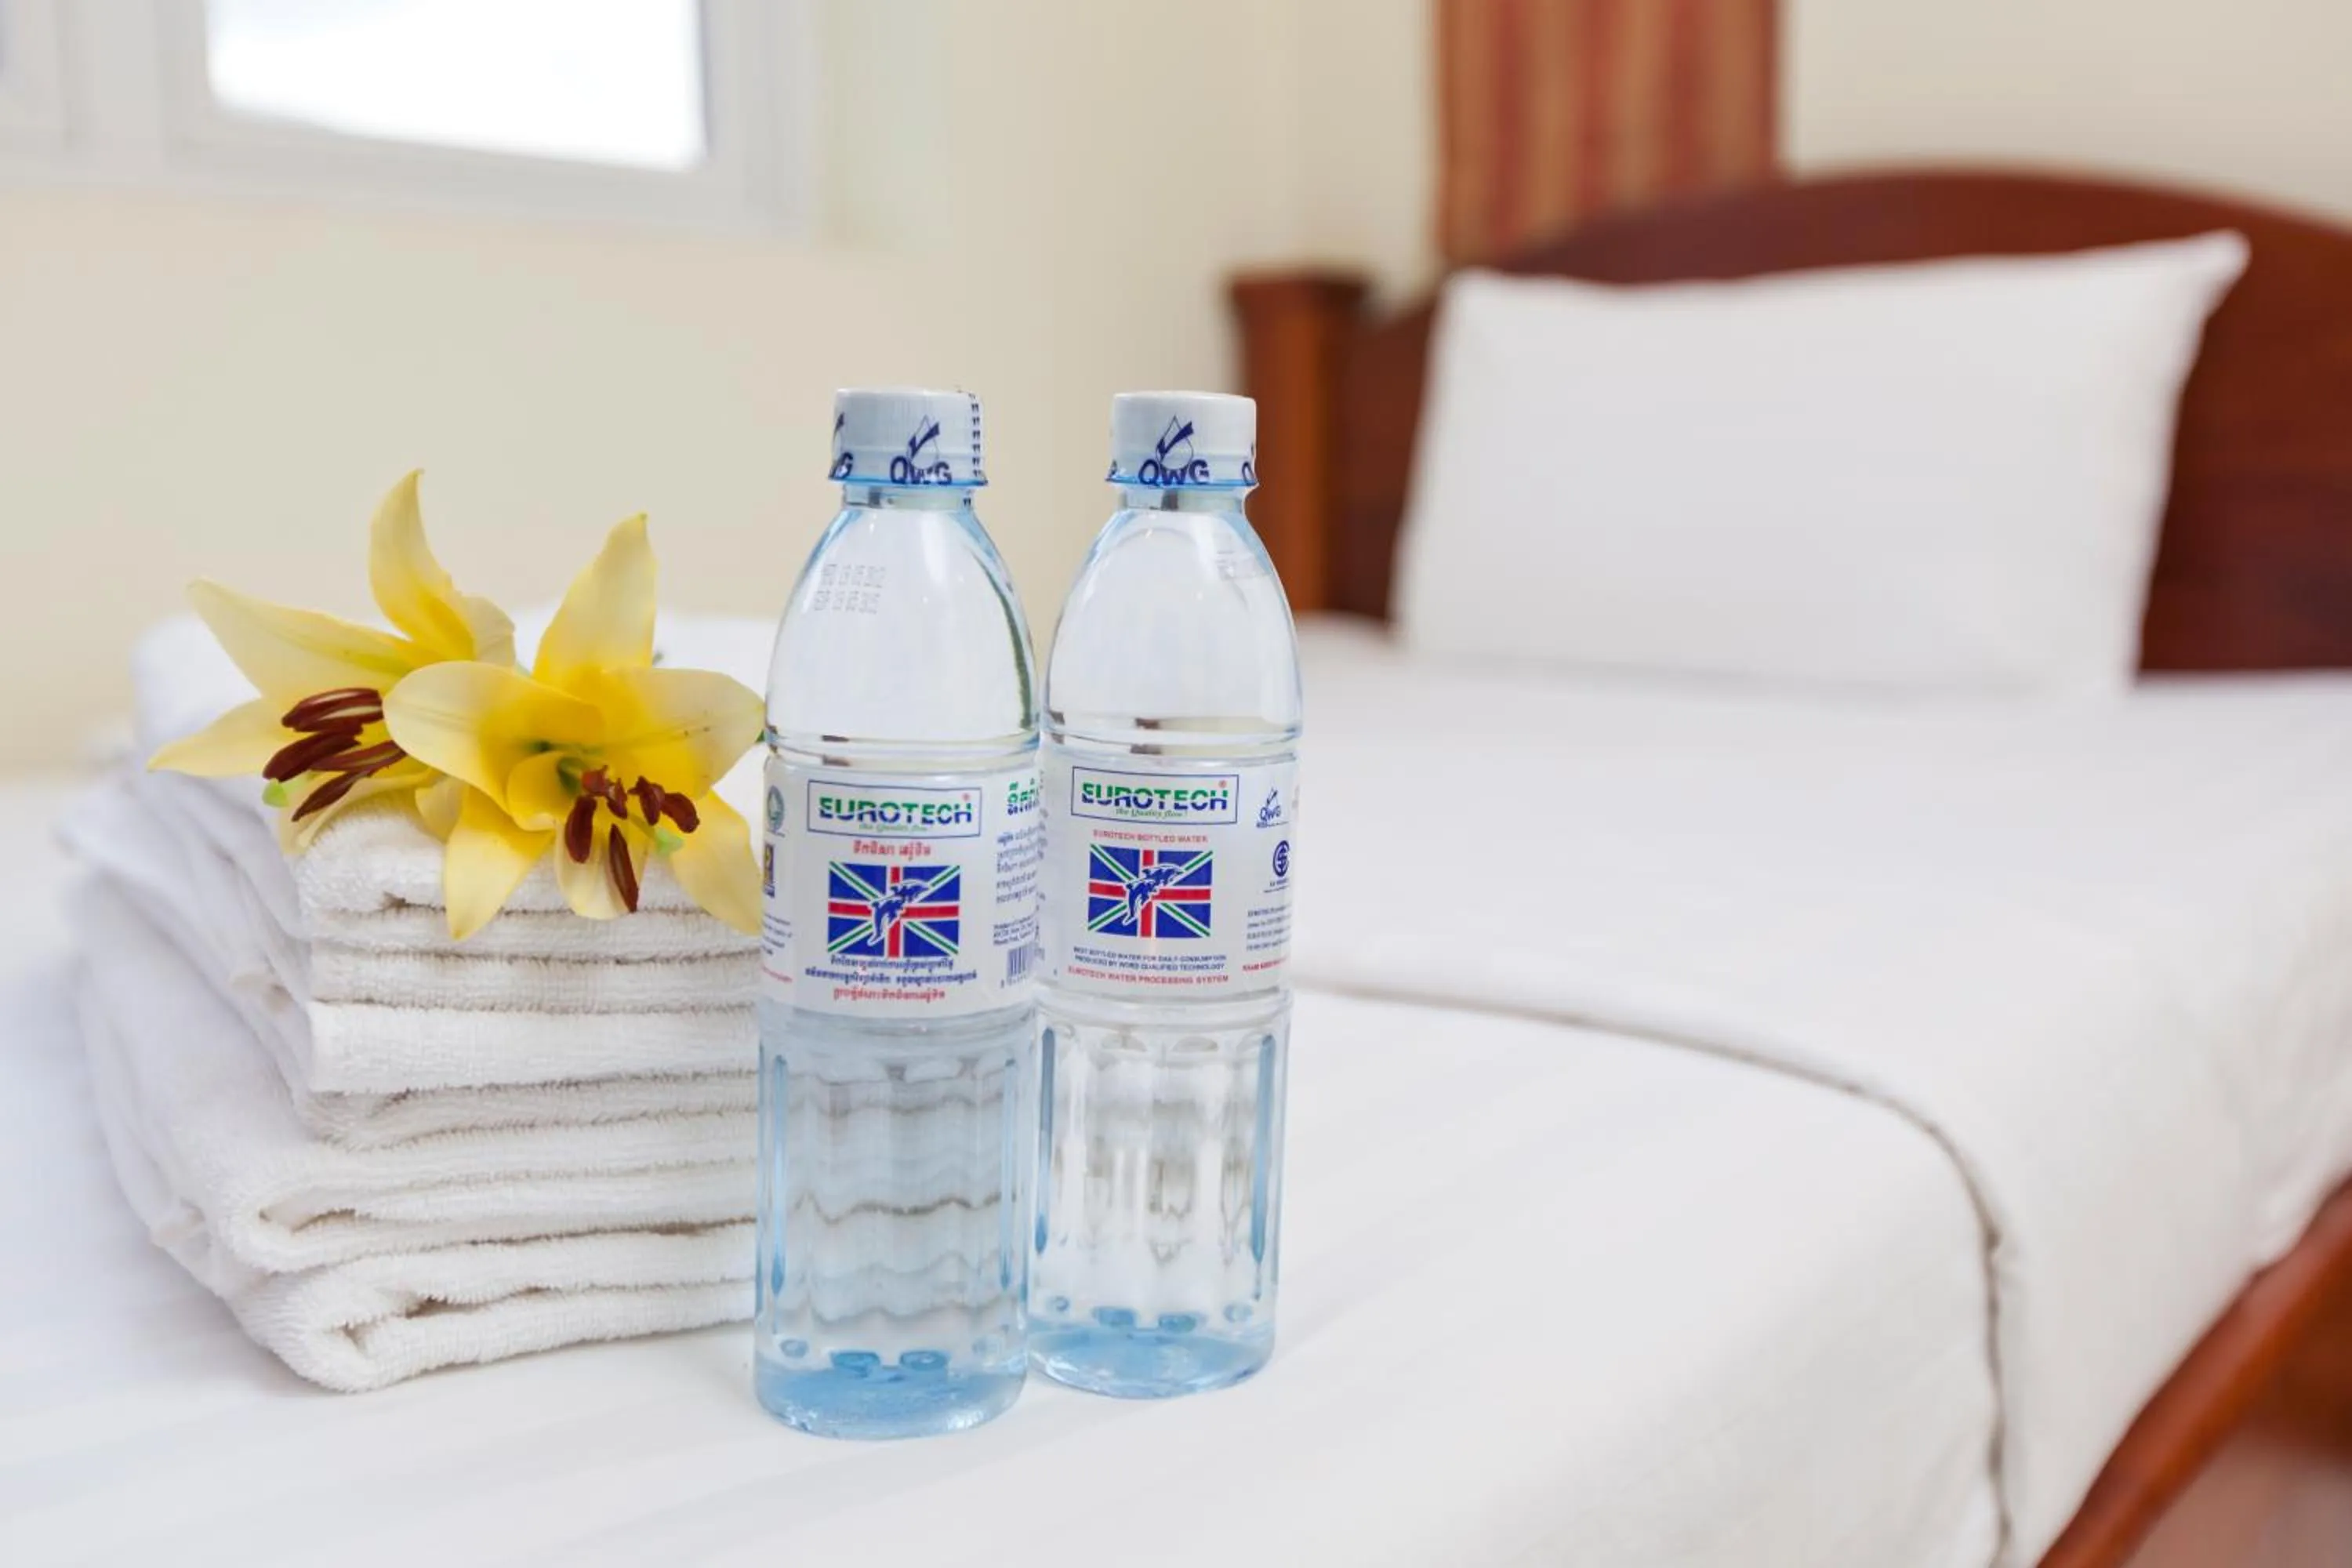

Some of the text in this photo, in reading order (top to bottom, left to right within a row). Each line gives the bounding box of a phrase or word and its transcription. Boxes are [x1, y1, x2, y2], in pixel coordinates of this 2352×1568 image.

[890, 456, 953, 485] QWG
[1138, 459, 1210, 487] QWG
[1080, 782, 1229, 811] EUROTECH
[818, 797, 972, 825] EUROTECH
[1093, 829, 1135, 840] EUROTECH
[1137, 833, 1175, 843] BOTTLED
[1068, 965, 1229, 985] EUROTECH WATER PROCESSING SYSTEM
